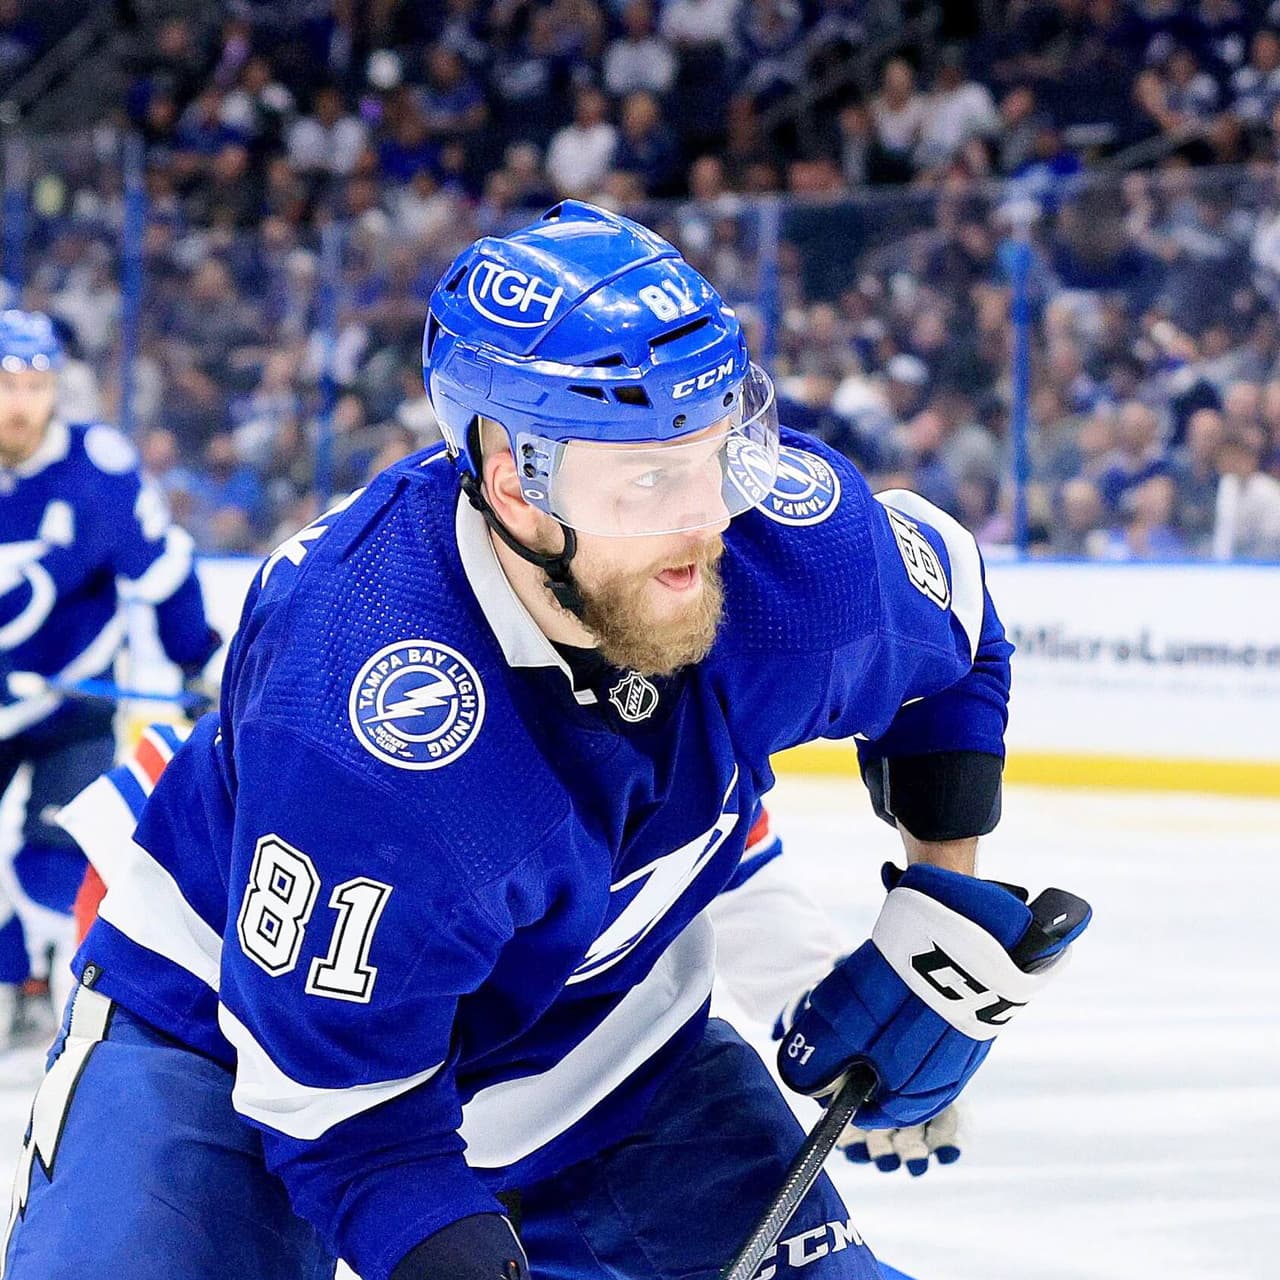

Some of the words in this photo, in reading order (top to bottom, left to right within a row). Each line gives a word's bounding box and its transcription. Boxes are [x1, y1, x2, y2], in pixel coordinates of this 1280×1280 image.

[479, 260, 564, 321] TGH
[639, 279, 700, 322] 81
[672, 360, 736, 400] CCM
[773, 496, 826, 515] TAMPA
[408, 649, 447, 666] BAY
[360, 654, 403, 709] TAMPA
[628, 683, 642, 715] NHL
[427, 663, 476, 757] LIGHTNING
[236, 832, 394, 1003] 81
[787, 1031, 816, 1066] 81
